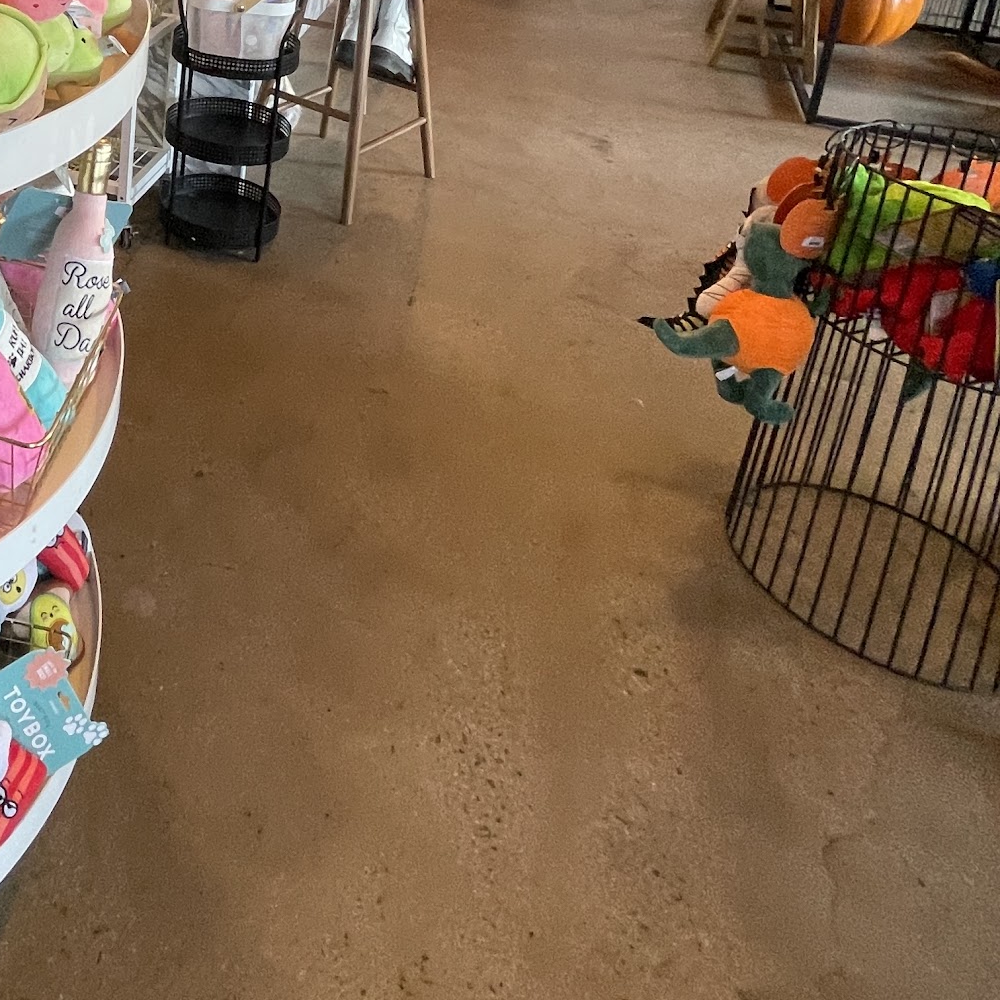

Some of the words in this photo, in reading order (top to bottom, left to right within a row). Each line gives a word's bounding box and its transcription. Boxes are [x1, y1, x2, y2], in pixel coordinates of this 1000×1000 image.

[61, 261, 111, 290] Rose
[62, 294, 96, 320] all
[3, 685, 56, 762] TOYBOX
